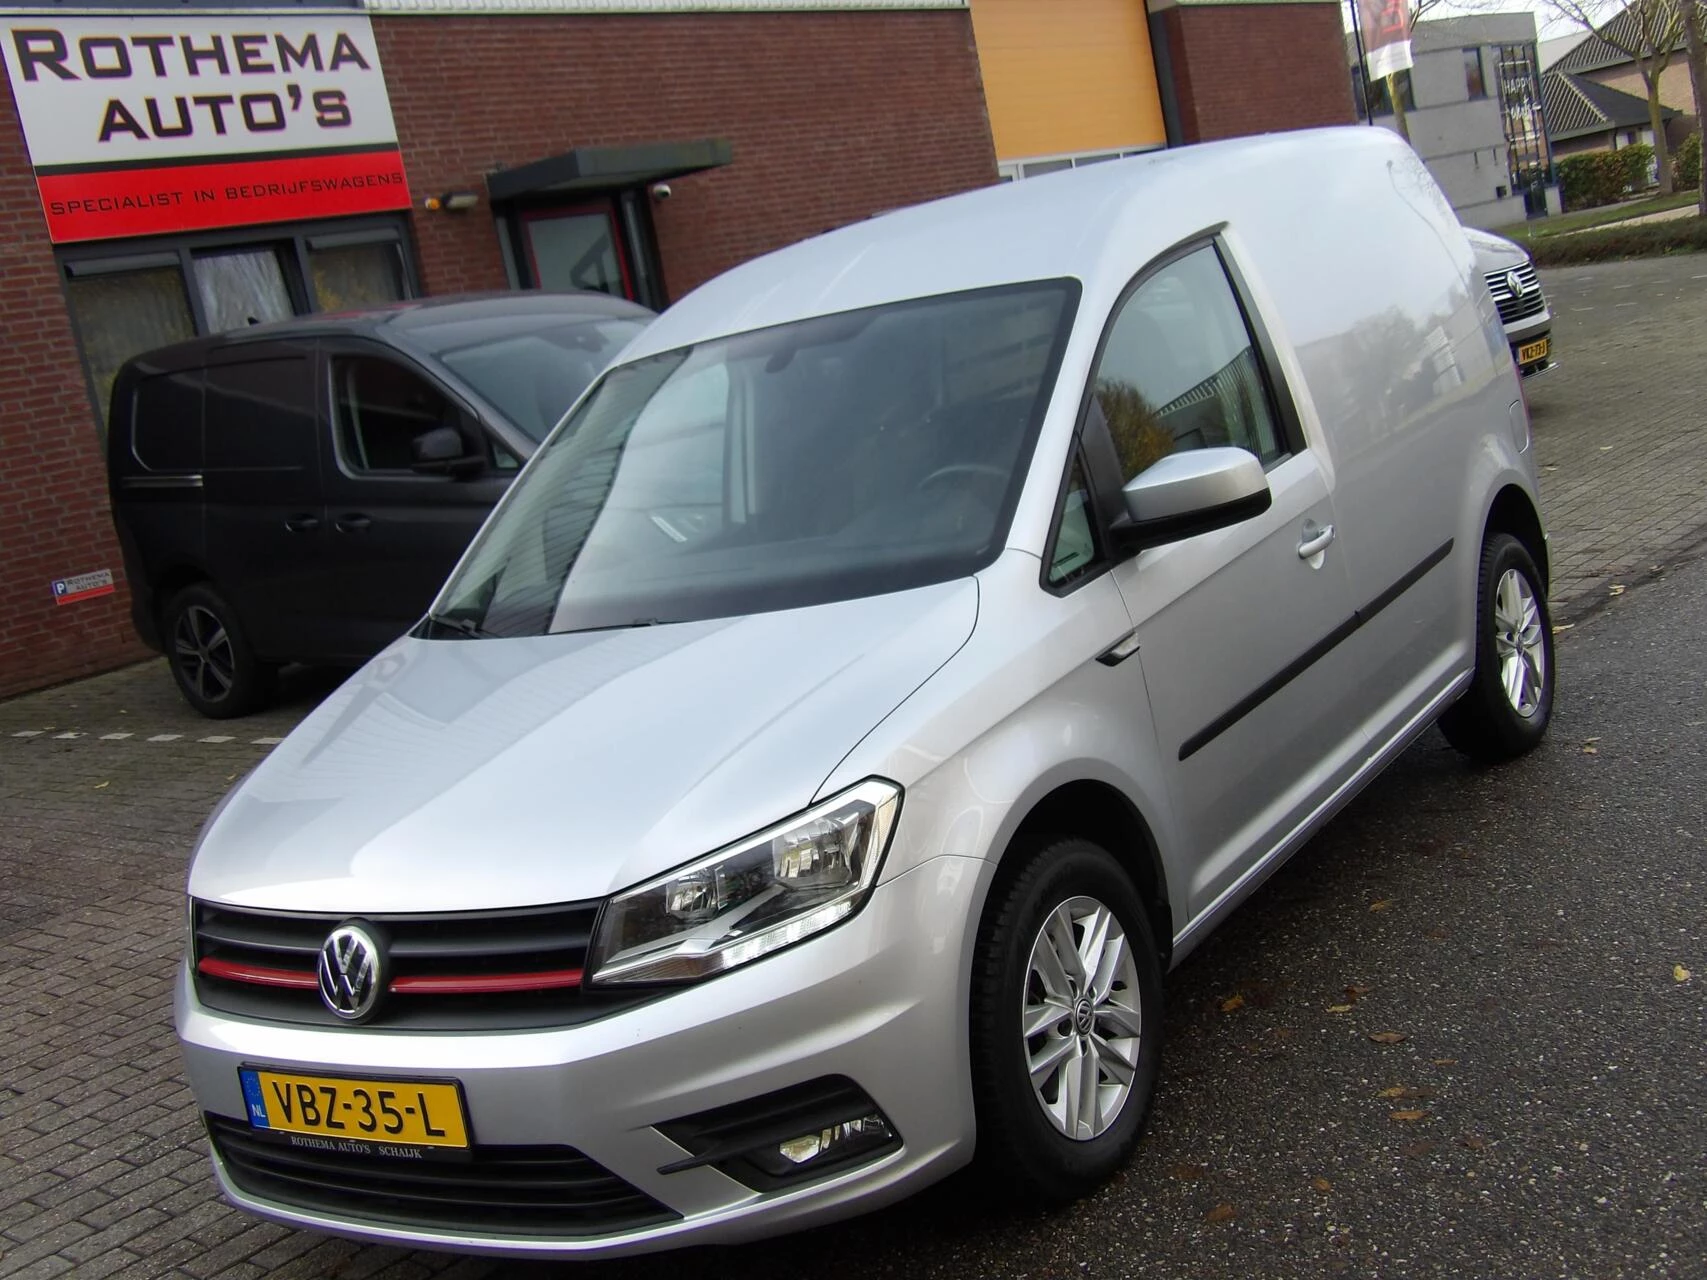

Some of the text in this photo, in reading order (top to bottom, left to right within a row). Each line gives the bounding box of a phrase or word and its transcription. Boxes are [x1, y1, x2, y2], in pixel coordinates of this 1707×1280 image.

[11, 28, 372, 82] ROTHEMA
[98, 84, 352, 142] AUTO'S
[50, 172, 404, 216] SPECIALIST IN BEDRIJFSWAGENS
[56, 583, 65, 594] P
[251, 1081, 446, 1138] NL VBZ-35-L
[291, 1136, 422, 1159] ROTHEMA AUTO'S SCHAIJK
